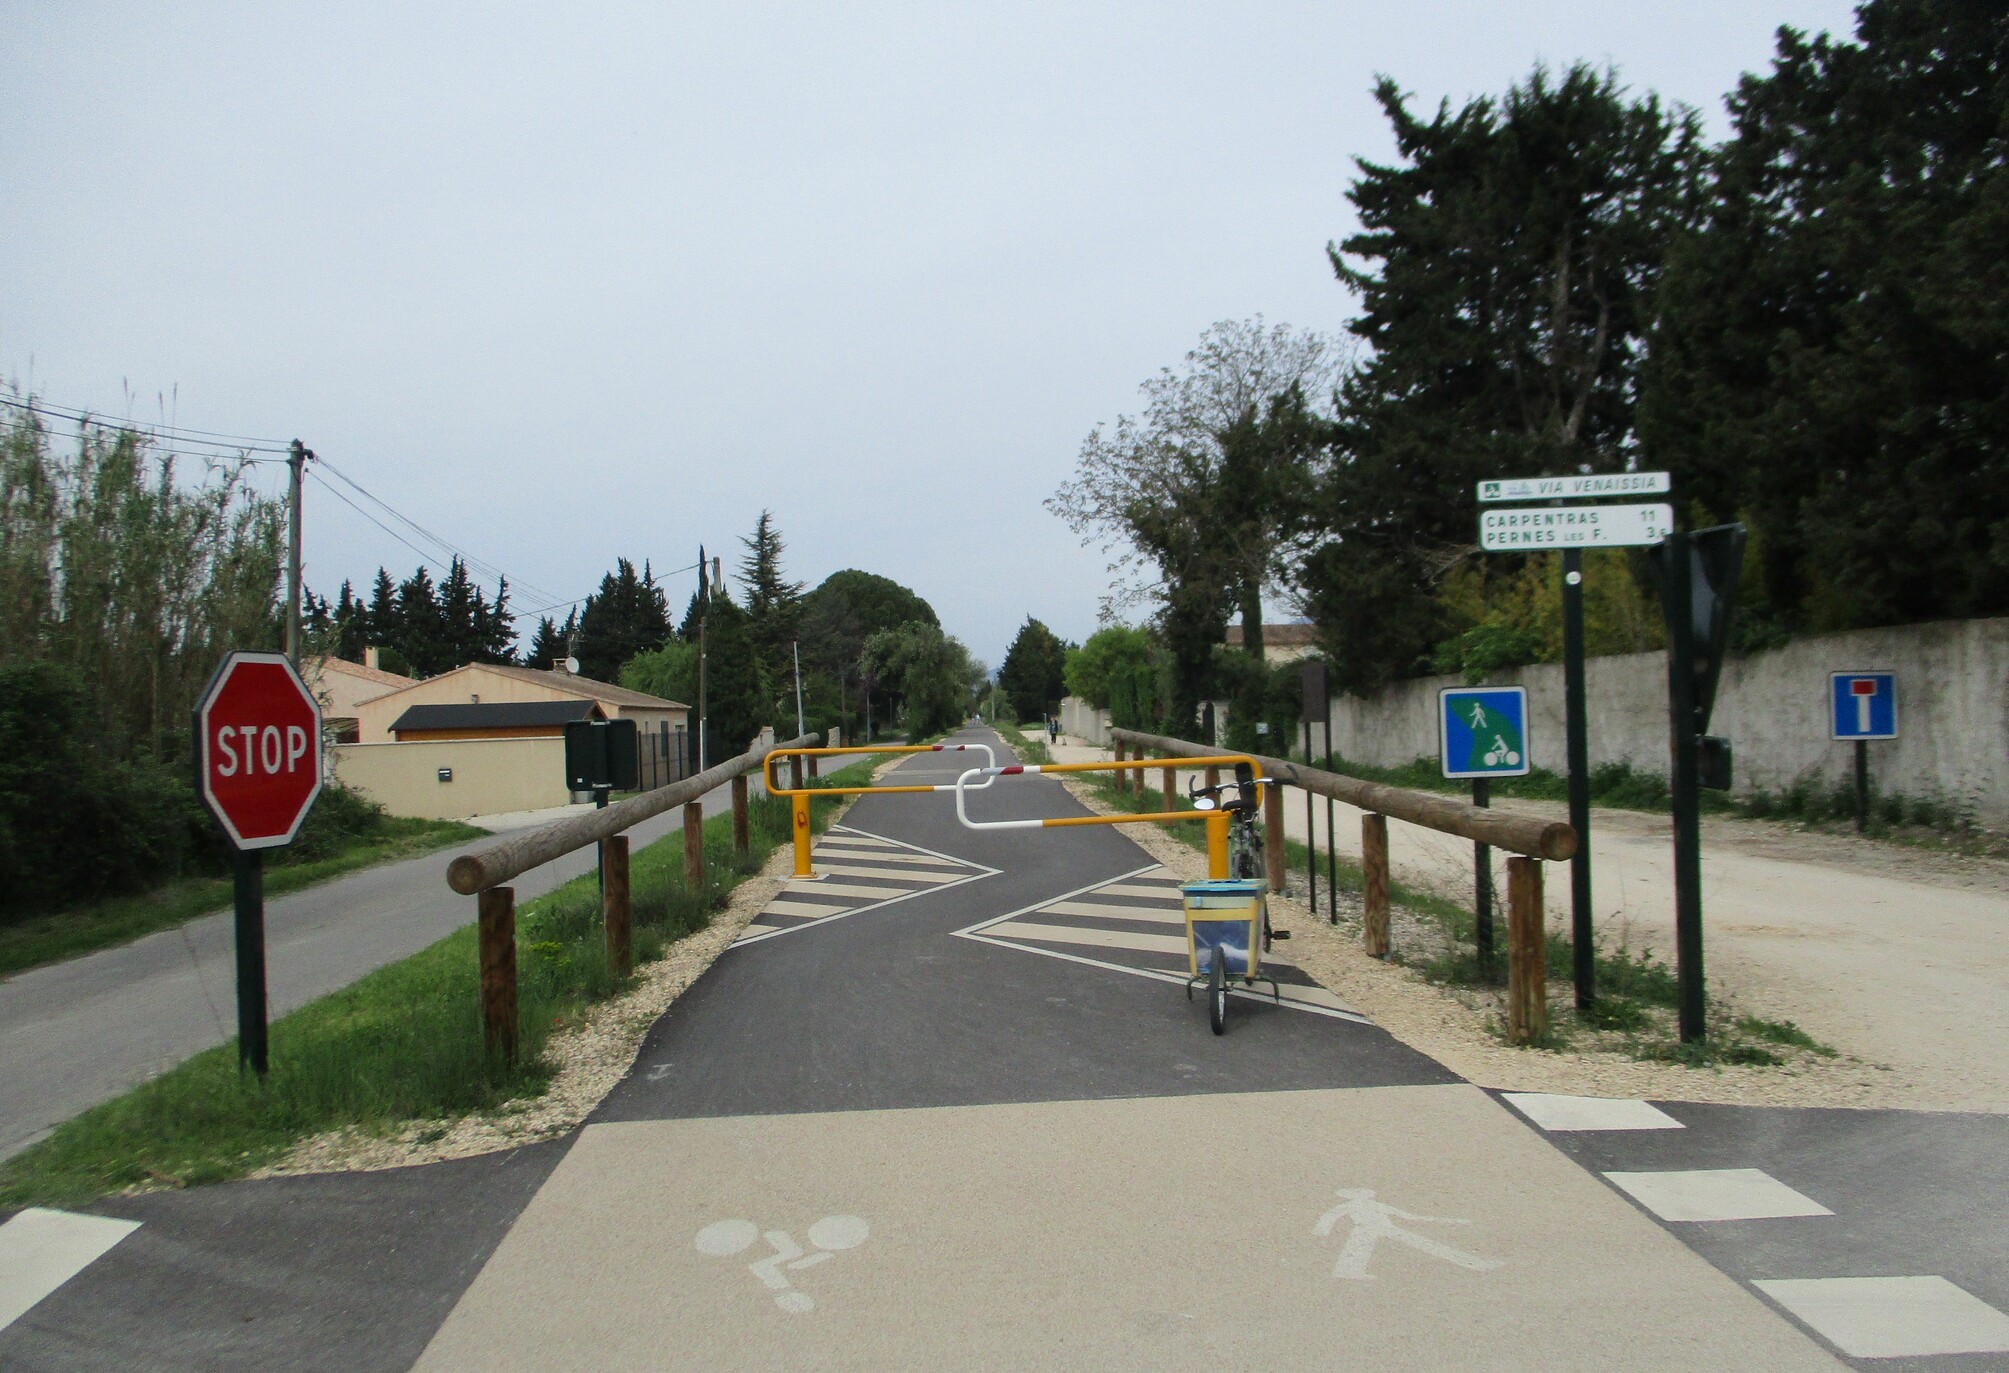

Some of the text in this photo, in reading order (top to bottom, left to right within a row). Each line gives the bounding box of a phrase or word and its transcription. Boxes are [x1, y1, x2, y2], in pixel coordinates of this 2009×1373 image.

[1539, 482, 1563, 494] VIA
[1574, 477, 1656, 491] VENAISSIA
[1487, 510, 1656, 528] CARPENTRAS 11
[1487, 529, 1556, 544] PERNES
[1564, 532, 1585, 541] LES
[217, 725, 307, 777] STOP
